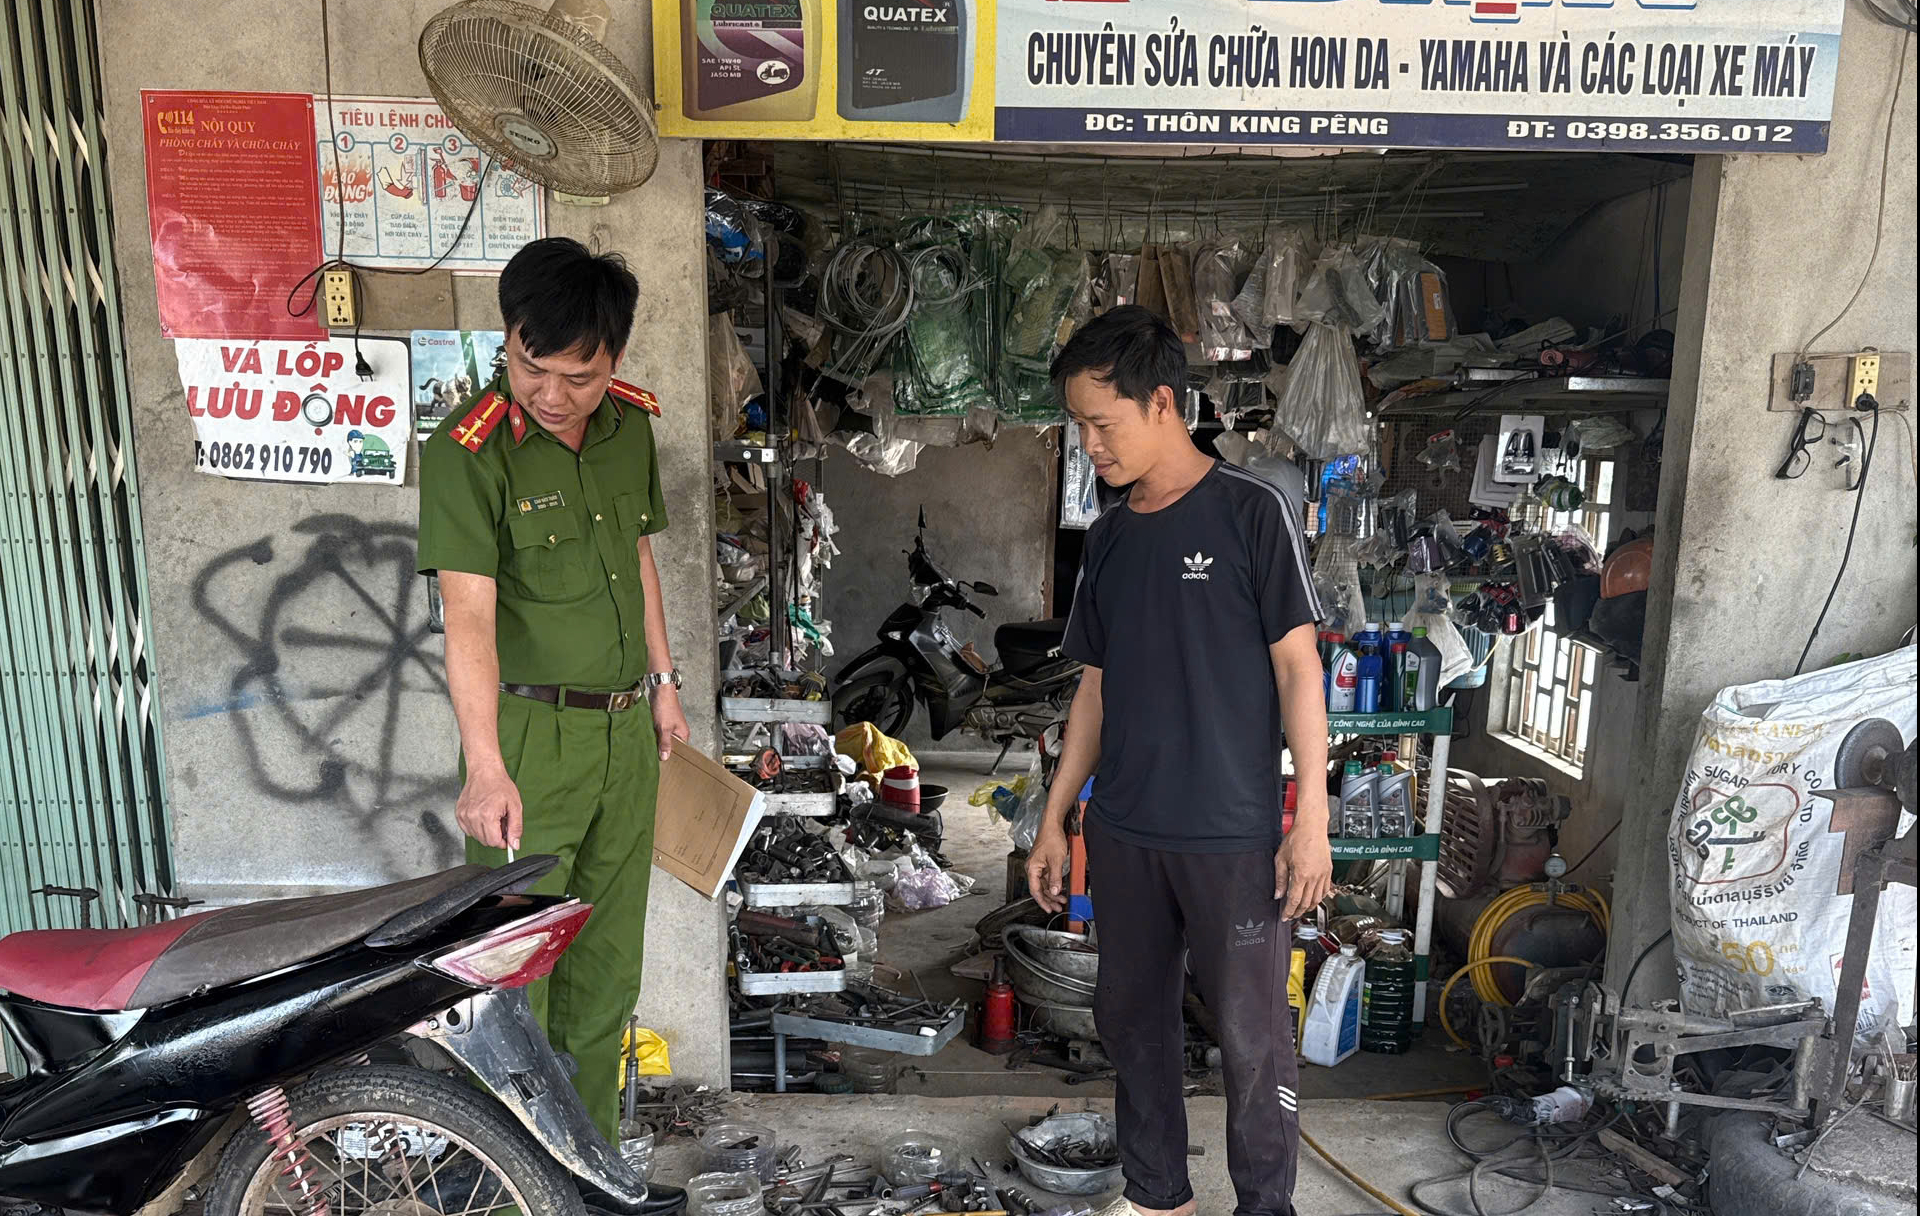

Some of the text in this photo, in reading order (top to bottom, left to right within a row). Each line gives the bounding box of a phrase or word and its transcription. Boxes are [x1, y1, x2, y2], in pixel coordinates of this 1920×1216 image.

[711, 3, 797, 18] QUATEX
[864, 6, 947, 22] QUATEX
[1027, 22, 1136, 86] CHUYÊN
[1144, 16, 1199, 87] SỬA
[1207, 25, 1281, 89] CHỮA
[1289, 36, 1348, 89] HON
[1354, 38, 1390, 90] DA
[1420, 39, 1528, 93] YAMAHA
[1539, 30, 1571, 94] VÀ
[1580, 31, 1636, 95] CÁC
[1642, 43, 1704, 107] LOẠI
[1708, 44, 1747, 96] XE
[1752, 35, 1816, 98] MÁY
[174, 110, 195, 125] 114
[339, 108, 374, 126] TIÊU
[380, 109, 419, 130] LỆNH
[1085, 111, 1389, 135] ĐC: THÔN KING PÊNG
[200, 118, 225, 134] NỘI
[227, 120, 256, 134] QUY
[1507, 121, 1794, 142] ĐT: 0398.356.012
[159, 136, 301, 150] PHÒNG CHÁY VÀ CHỮA CHÁY
[341, 136, 348, 149] 1
[394, 137, 404, 150] 2
[448, 138, 458, 151] 3
[220, 341, 344, 378] VÁ LỐP
[187, 381, 396, 436] LƯU ĐỘNG
[210, 441, 255, 470] 0862
[260, 444, 294, 472] 910
[298, 446, 333, 475] 790
[1333, 719, 1355, 728] CÔNG
[1355, 718, 1376, 729] NGHỆ
[1410, 720, 1426, 728] CAO
[1704, 765, 1749, 789] SUGAR
[1343, 845, 1364, 855] NGHỆ
[1712, 919, 1727, 930] OF
[1732, 911, 1798, 928] THAILAND
[1234, 936, 1265, 947] adidas
[1721, 940, 1774, 977] 50
